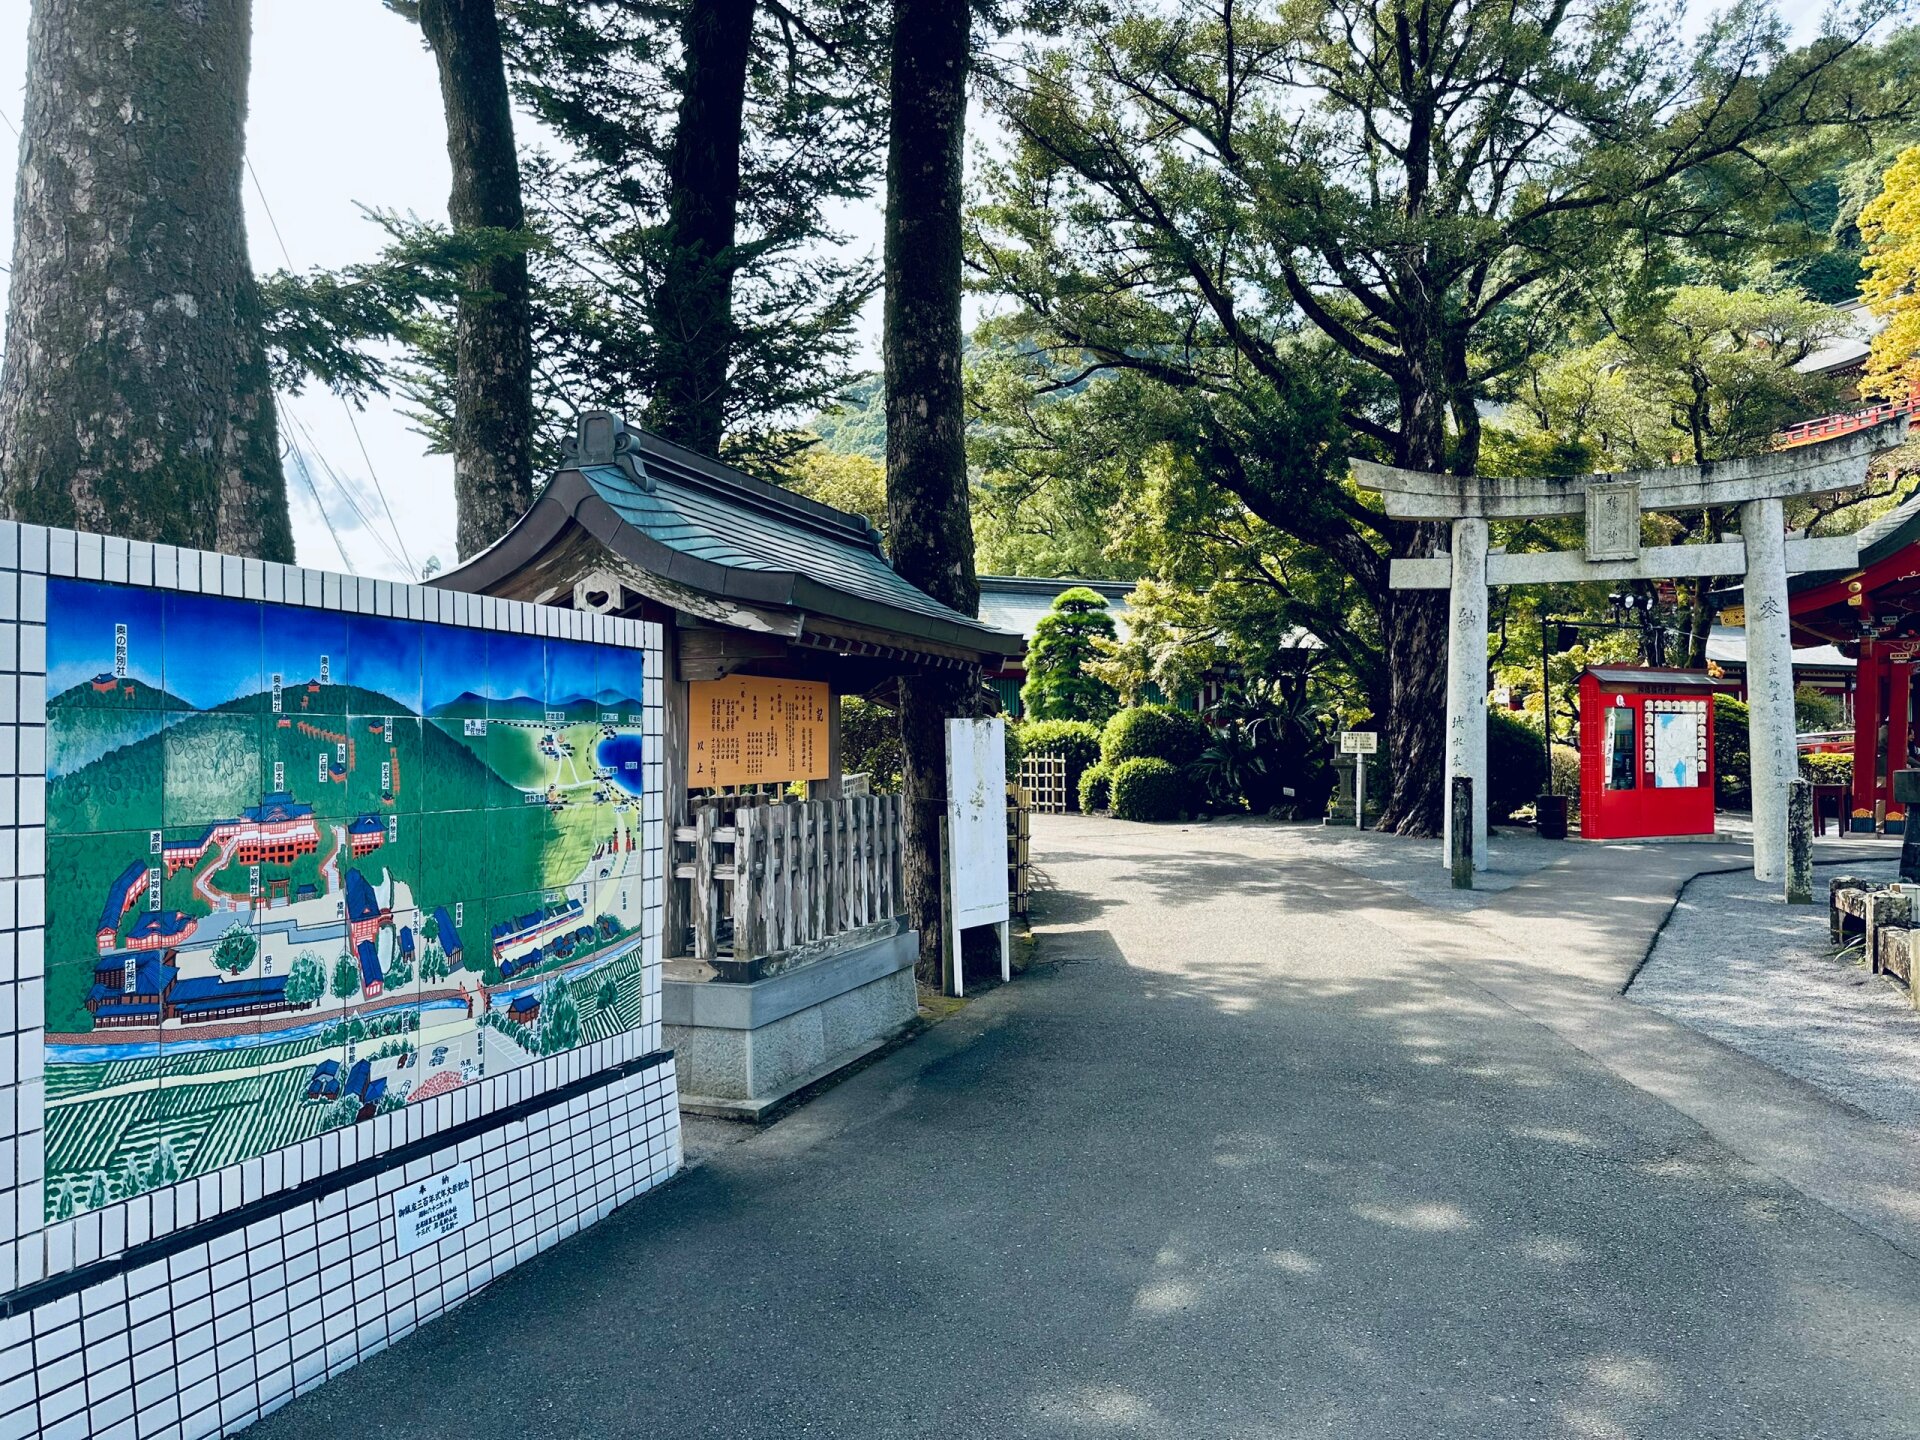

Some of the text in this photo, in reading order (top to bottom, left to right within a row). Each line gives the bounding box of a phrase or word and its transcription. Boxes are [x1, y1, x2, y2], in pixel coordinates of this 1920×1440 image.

[117, 625, 126, 676] 奥の院別社
[321, 656, 329, 683] 奥の院
[275, 763, 283, 791] 御本殿
[382, 763, 390, 788] 岩本社
[150, 869, 160, 910] 御神楽殿
[250, 867, 259, 895] 岩崎社
[126, 960, 135, 991] 社務所
[264, 956, 272, 974] 受付
